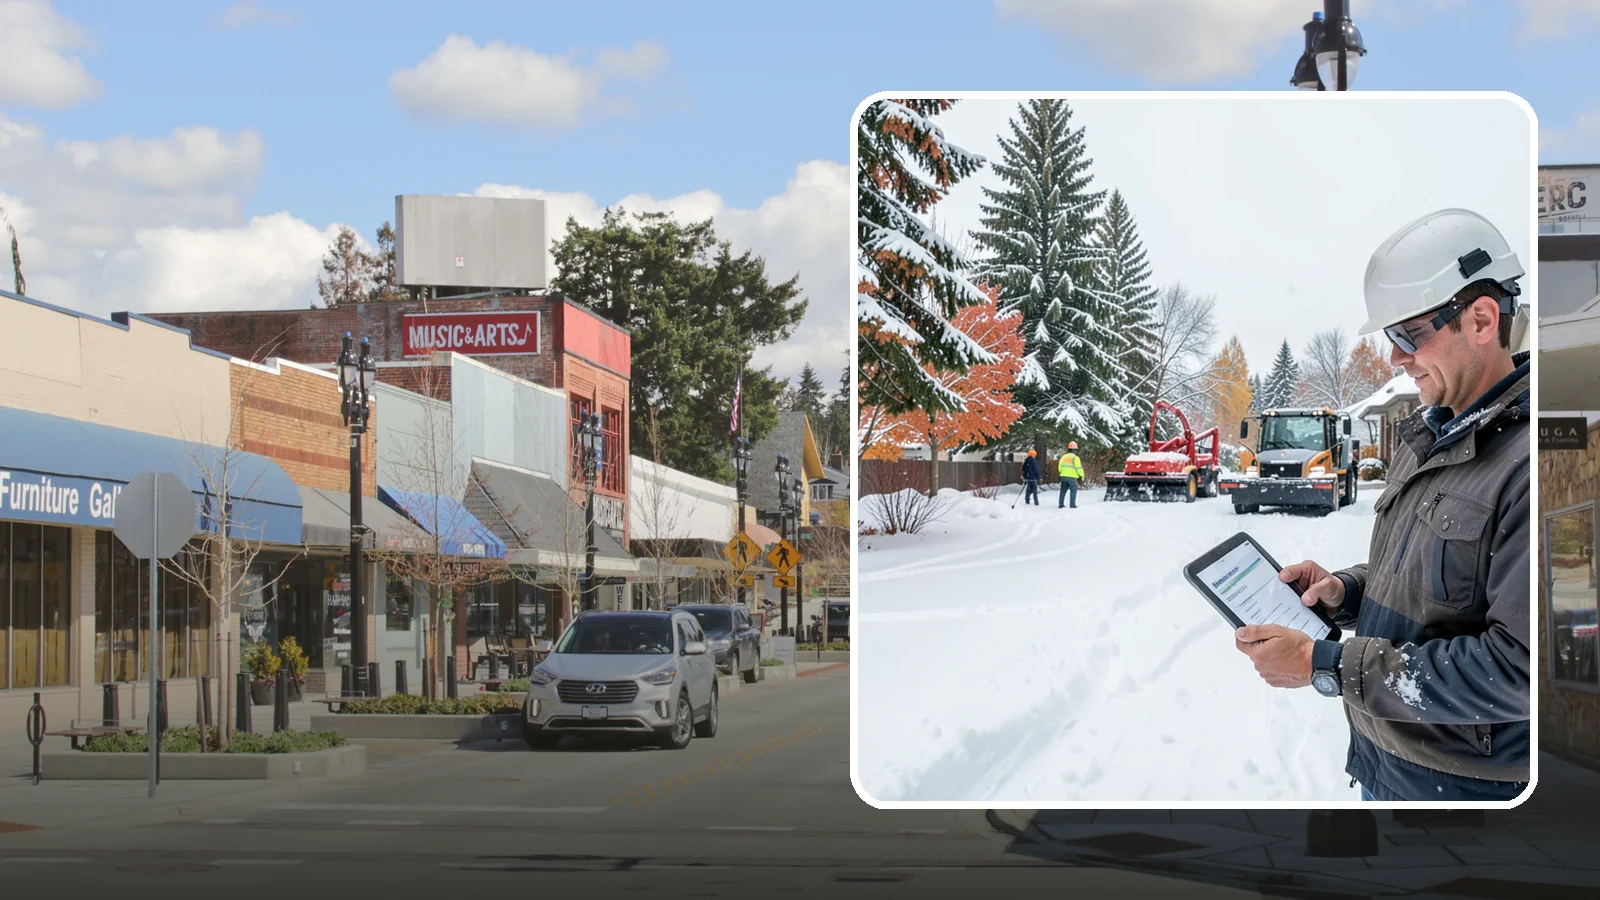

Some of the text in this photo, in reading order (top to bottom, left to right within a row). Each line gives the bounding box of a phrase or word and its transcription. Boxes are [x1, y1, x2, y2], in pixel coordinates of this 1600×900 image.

[1541, 428, 1578, 436] UGA
[0, 471, 79, 515] Furniture
[454, 563, 479, 573] SUSHI
